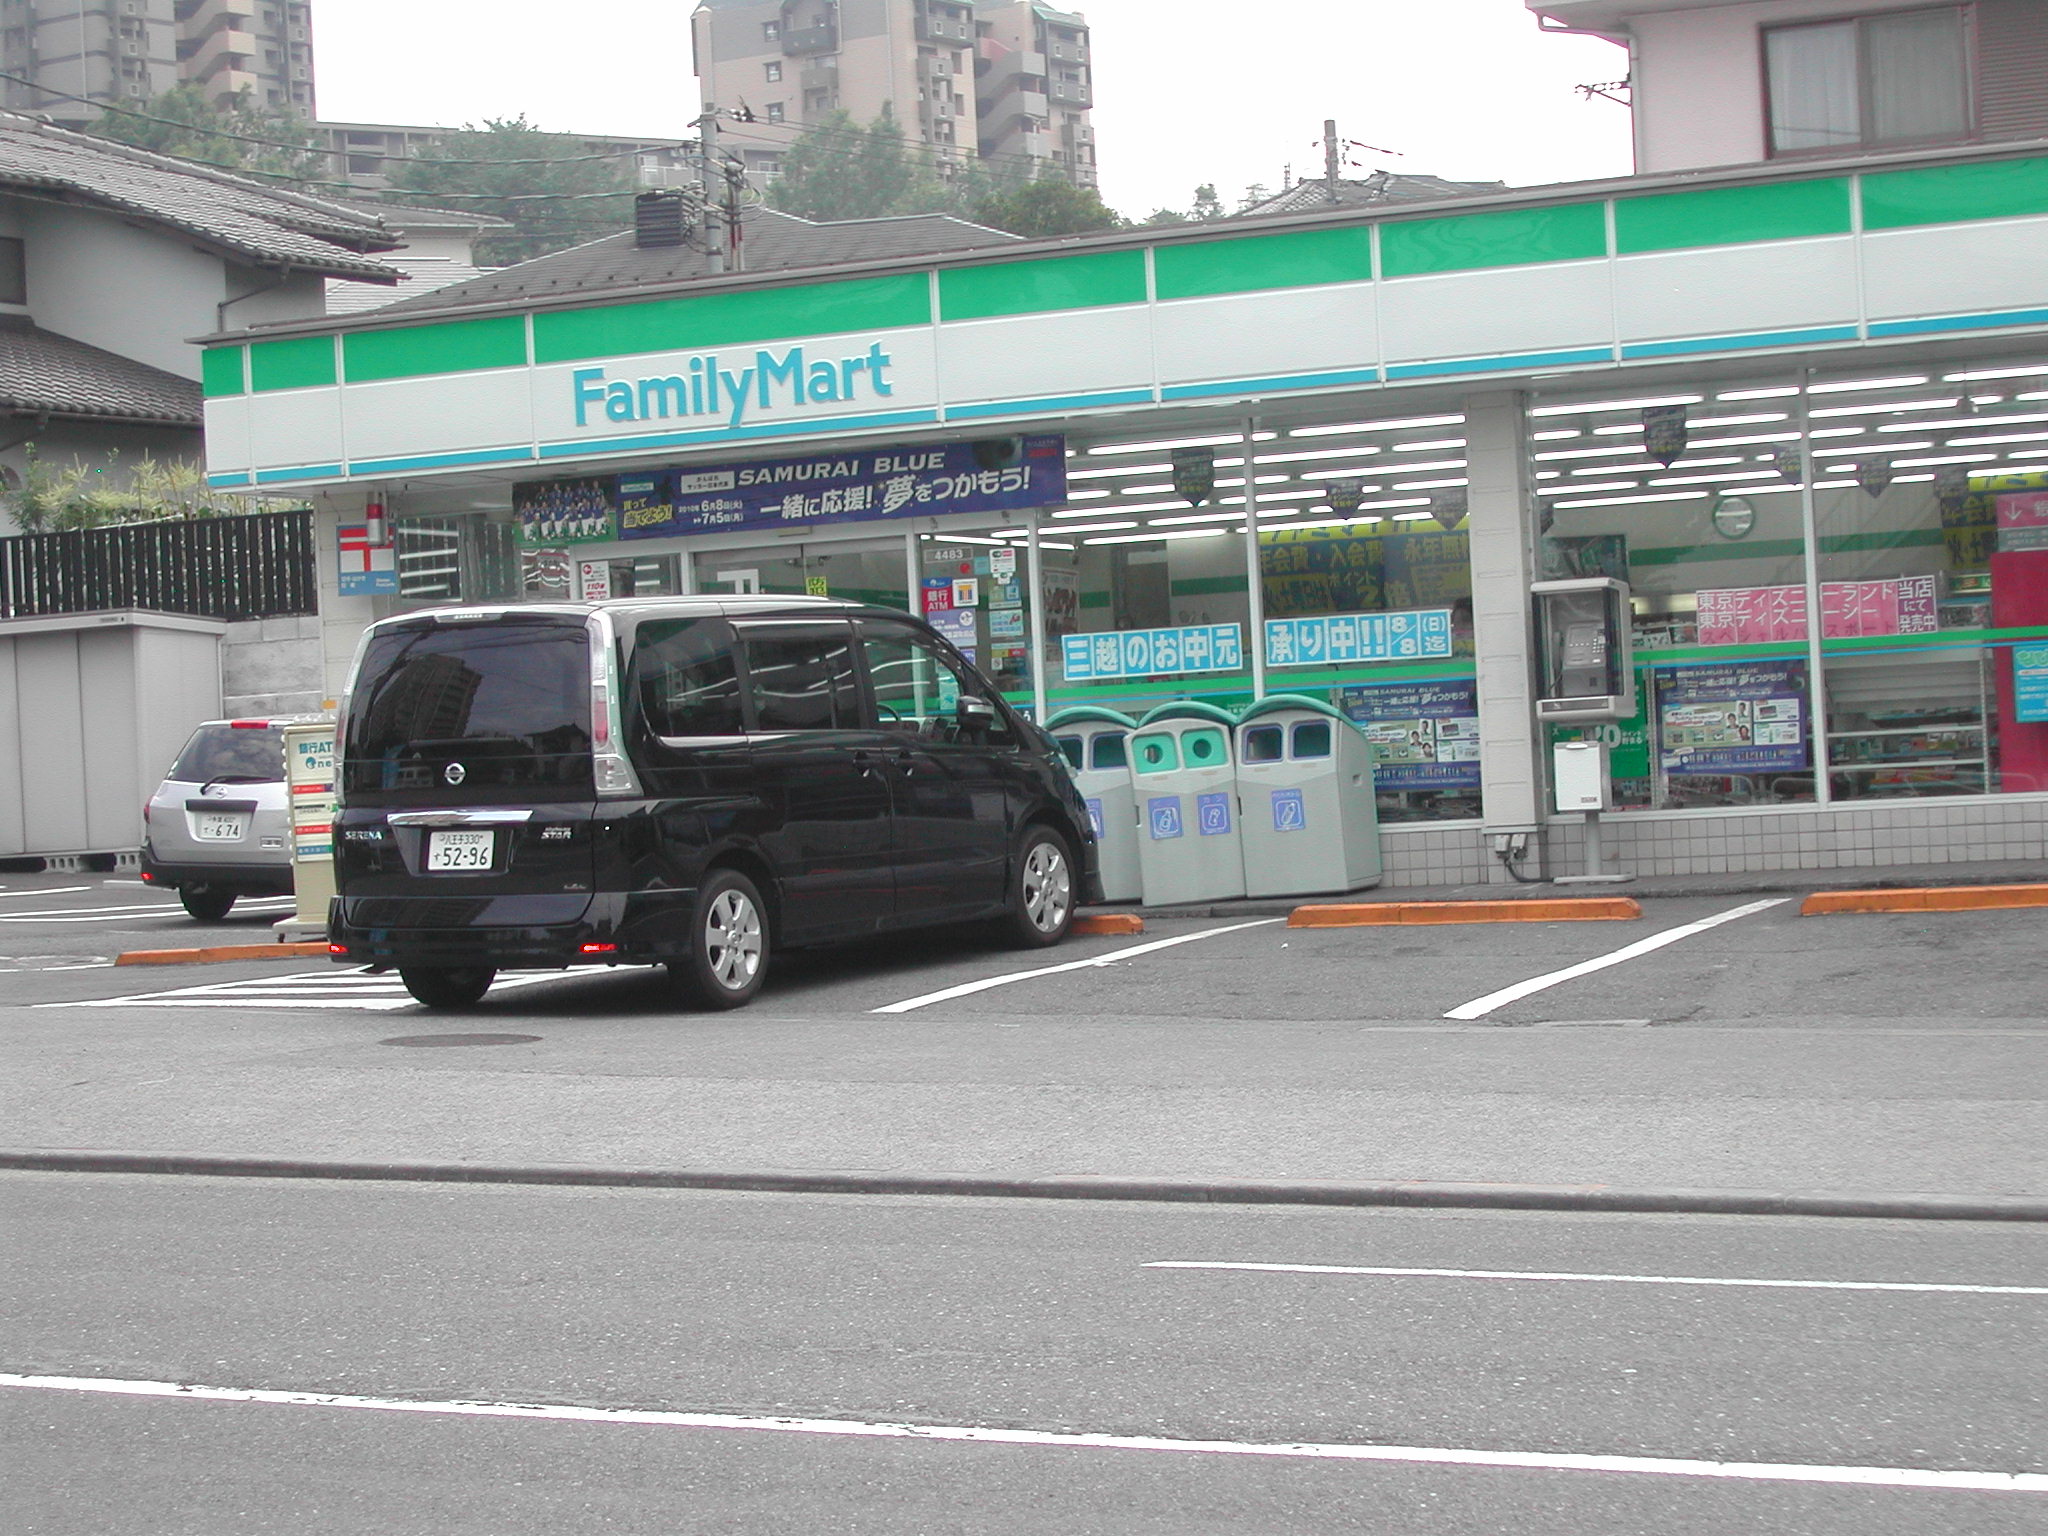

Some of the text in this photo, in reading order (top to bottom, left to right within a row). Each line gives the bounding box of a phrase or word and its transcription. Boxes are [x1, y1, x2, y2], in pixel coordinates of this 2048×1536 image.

[573, 338, 893, 429] FamilyMart
[738, 452, 945, 486] SAMURAI BLUE
[882, 465, 1031, 514] 夢をつかもう!
[1899, 579, 1932, 599] 当店
[927, 601, 949, 611] ATM
[1904, 599, 1928, 612] にて
[1900, 612, 1936, 633] 発売中
[1066, 627, 1238, 675] 三越のお中元
[345, 831, 382, 840] SERENA
[464, 833, 480, 845] 330
[442, 847, 488, 866] 52-96
